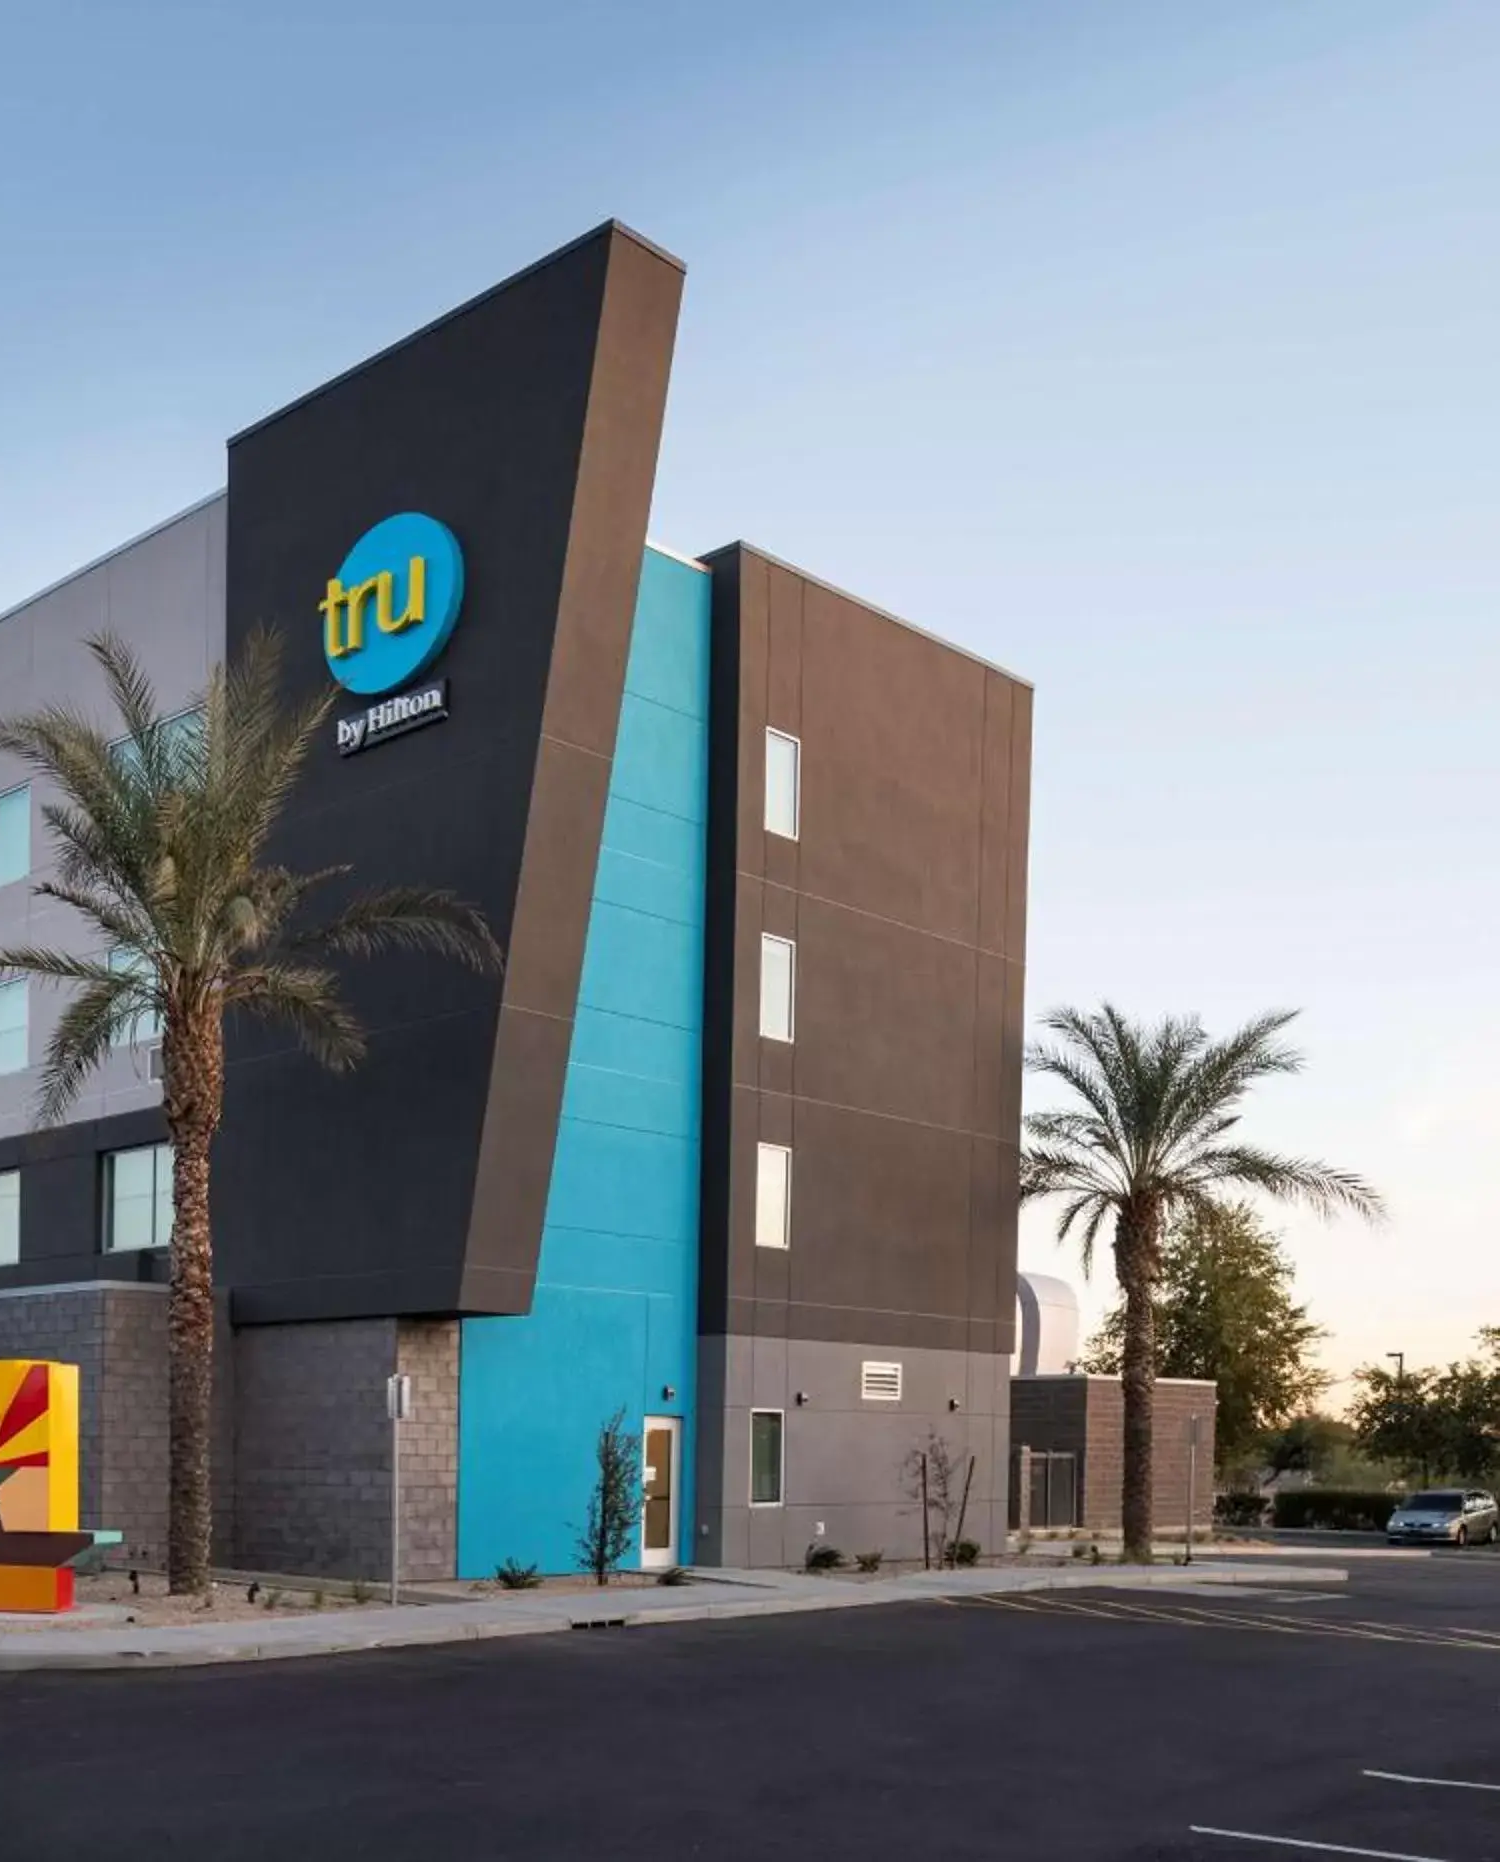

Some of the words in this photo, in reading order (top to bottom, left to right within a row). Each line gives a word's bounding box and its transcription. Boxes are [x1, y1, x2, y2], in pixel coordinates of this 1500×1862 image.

[318, 555, 426, 658] tru
[337, 719, 366, 746] by
[367, 689, 442, 732] Hilton
